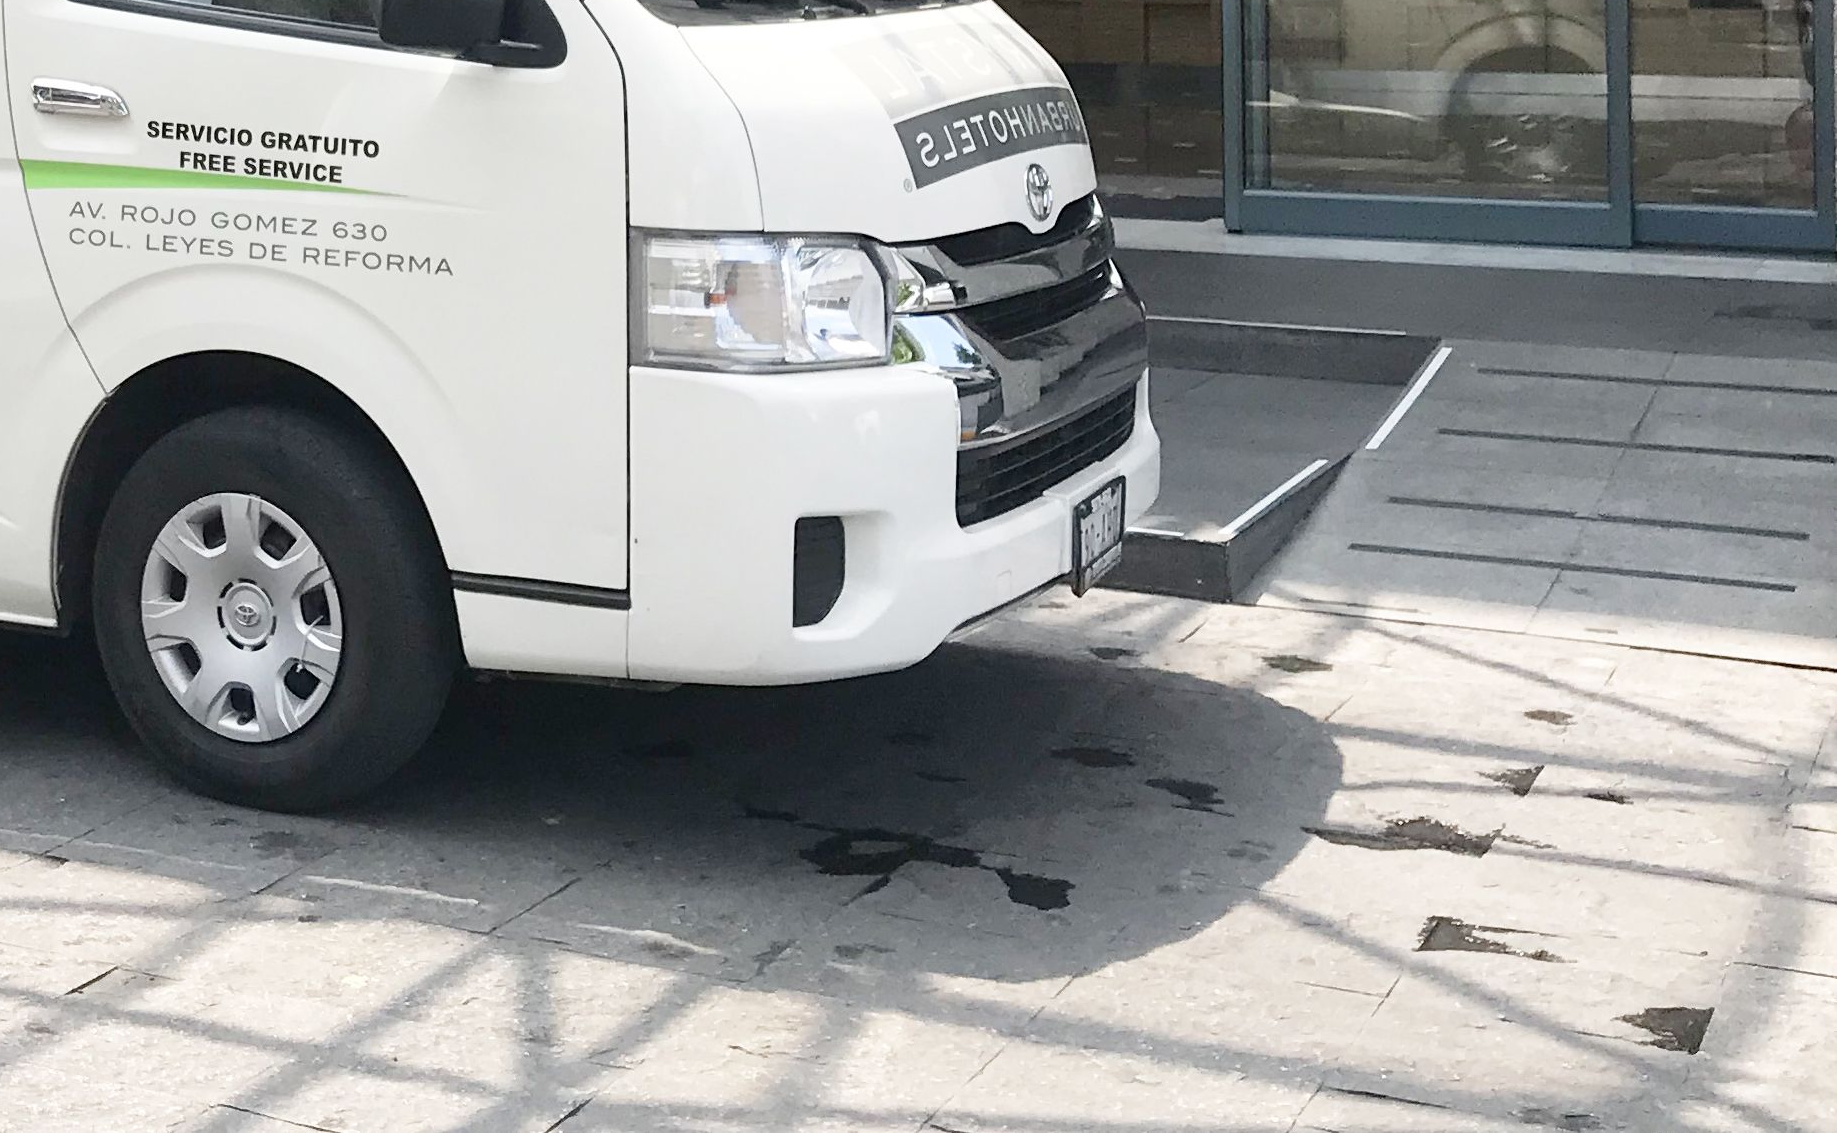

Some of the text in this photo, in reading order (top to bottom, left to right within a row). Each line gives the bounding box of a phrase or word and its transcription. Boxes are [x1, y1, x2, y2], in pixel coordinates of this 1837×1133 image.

[147, 120, 380, 159] SERVICIO GRATUITO
[179, 151, 343, 183] FREE SERVICE
[69, 201, 388, 242] AV. ROJO GOMEZ 630
[69, 228, 453, 276] COL. LEYES DE REFORMA
